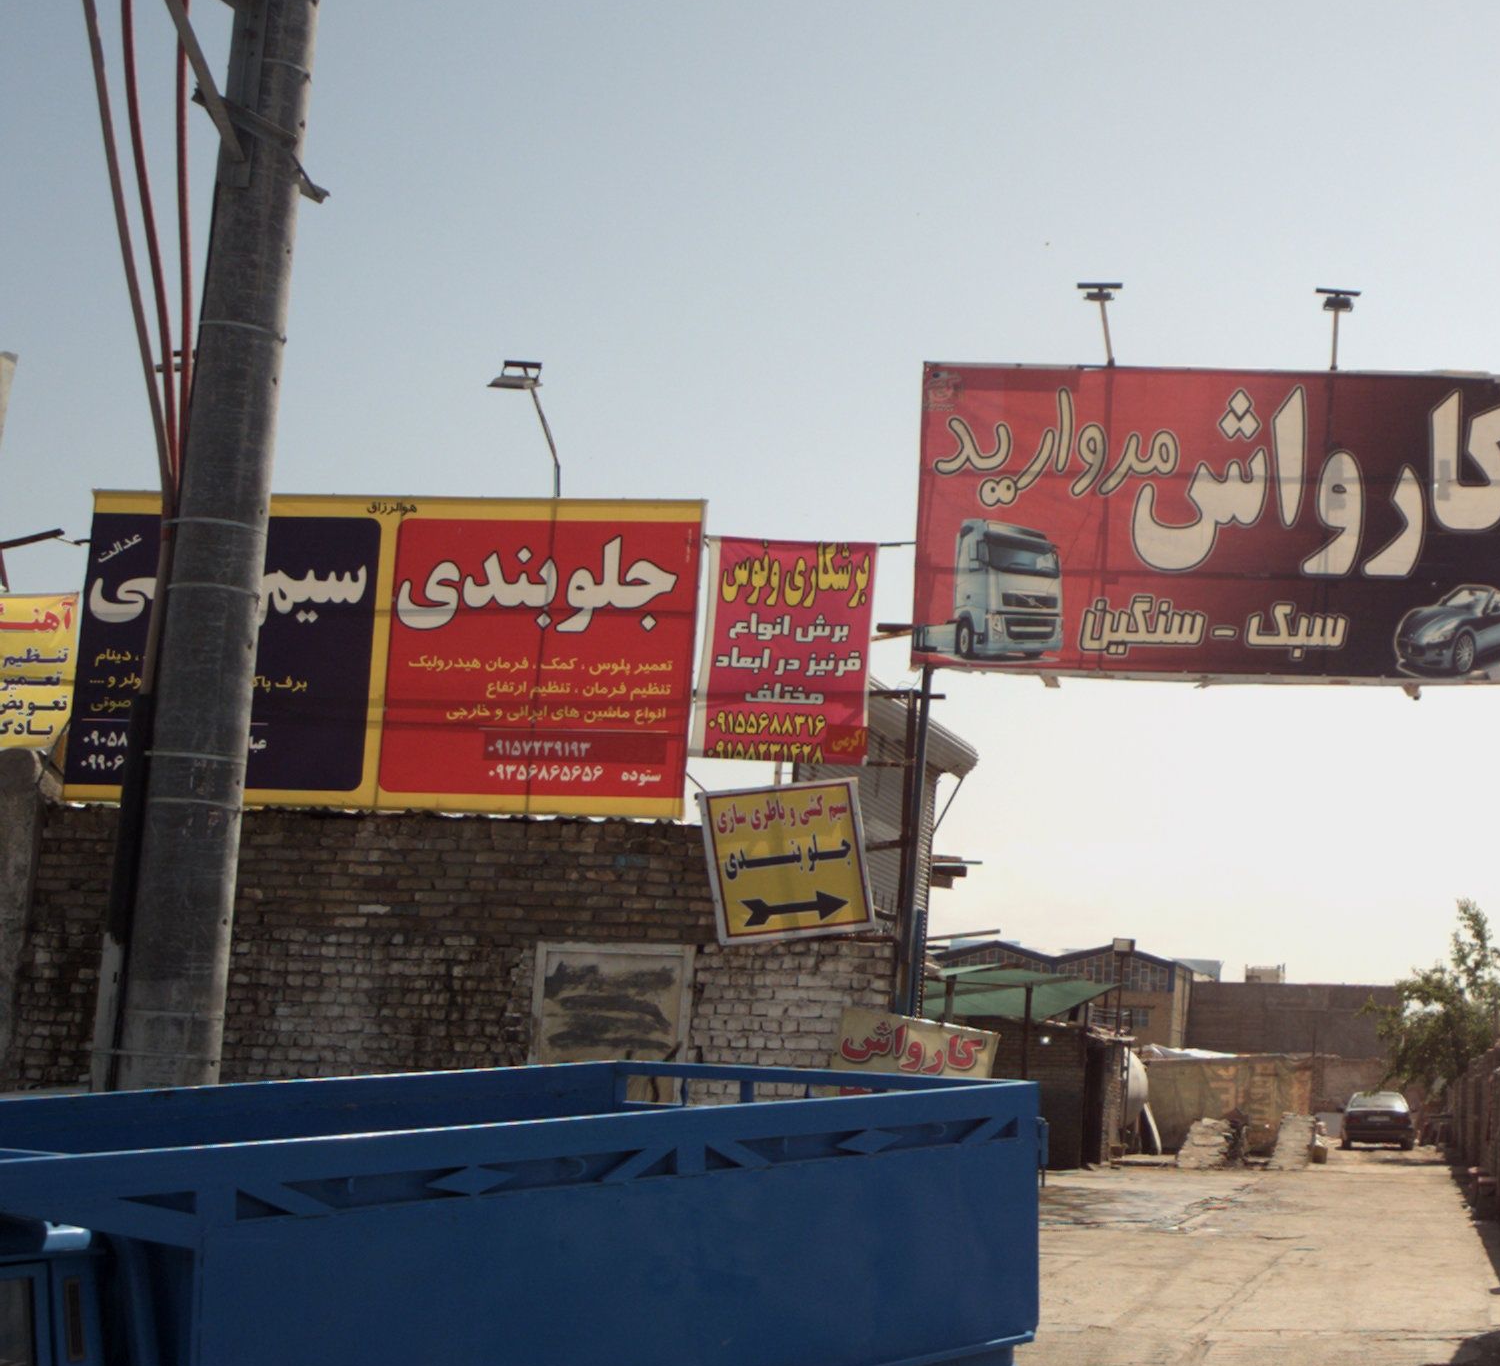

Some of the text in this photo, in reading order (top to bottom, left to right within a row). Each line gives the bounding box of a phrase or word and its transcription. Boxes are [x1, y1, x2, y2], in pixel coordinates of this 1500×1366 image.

[934, 387, 1180, 507] مروارید
[98, 534, 142, 563] عدالت
[721, 539, 780, 606] ونوس
[784, 541, 870, 608] برشکاری
[0, 602, 73, 632] آهن
[1079, 595, 1206, 656] سنگین
[729, 613, 849, 643] برش انواع
[1244, 601, 1349, 660] سبک
[3, 648, 68, 668] تنظیم
[95, 648, 132, 667] دینام
[409, 655, 481, 672] هیدرولیک
[485, 657, 529, 672] فرمان
[541, 657, 577, 671] کمک
[715, 646, 862, 676] قرنیز در ابعاد
[589, 658, 631, 676] پلوس
[635, 660, 673, 675] تعمیر
[122, 673, 142, 688] ولر
[275, 676, 308, 692] برف
[486, 681, 527, 698] ارتفاع
[530, 682, 571, 700] تنظیم
[583, 682, 626, 698] فرمان
[630, 683, 672, 701] تنظیم
[744, 683, 825, 704] مختلف
[446, 704, 666, 724] انواع ماشین های ایرانی و خارجی
[83, 730, 128, 747] ۰۹۰۵۸
[80, 753, 125, 771] ۰۹۹۰۶
[621, 769, 662, 786] ستوده
[840, 1021, 984, 1075] کارواش
